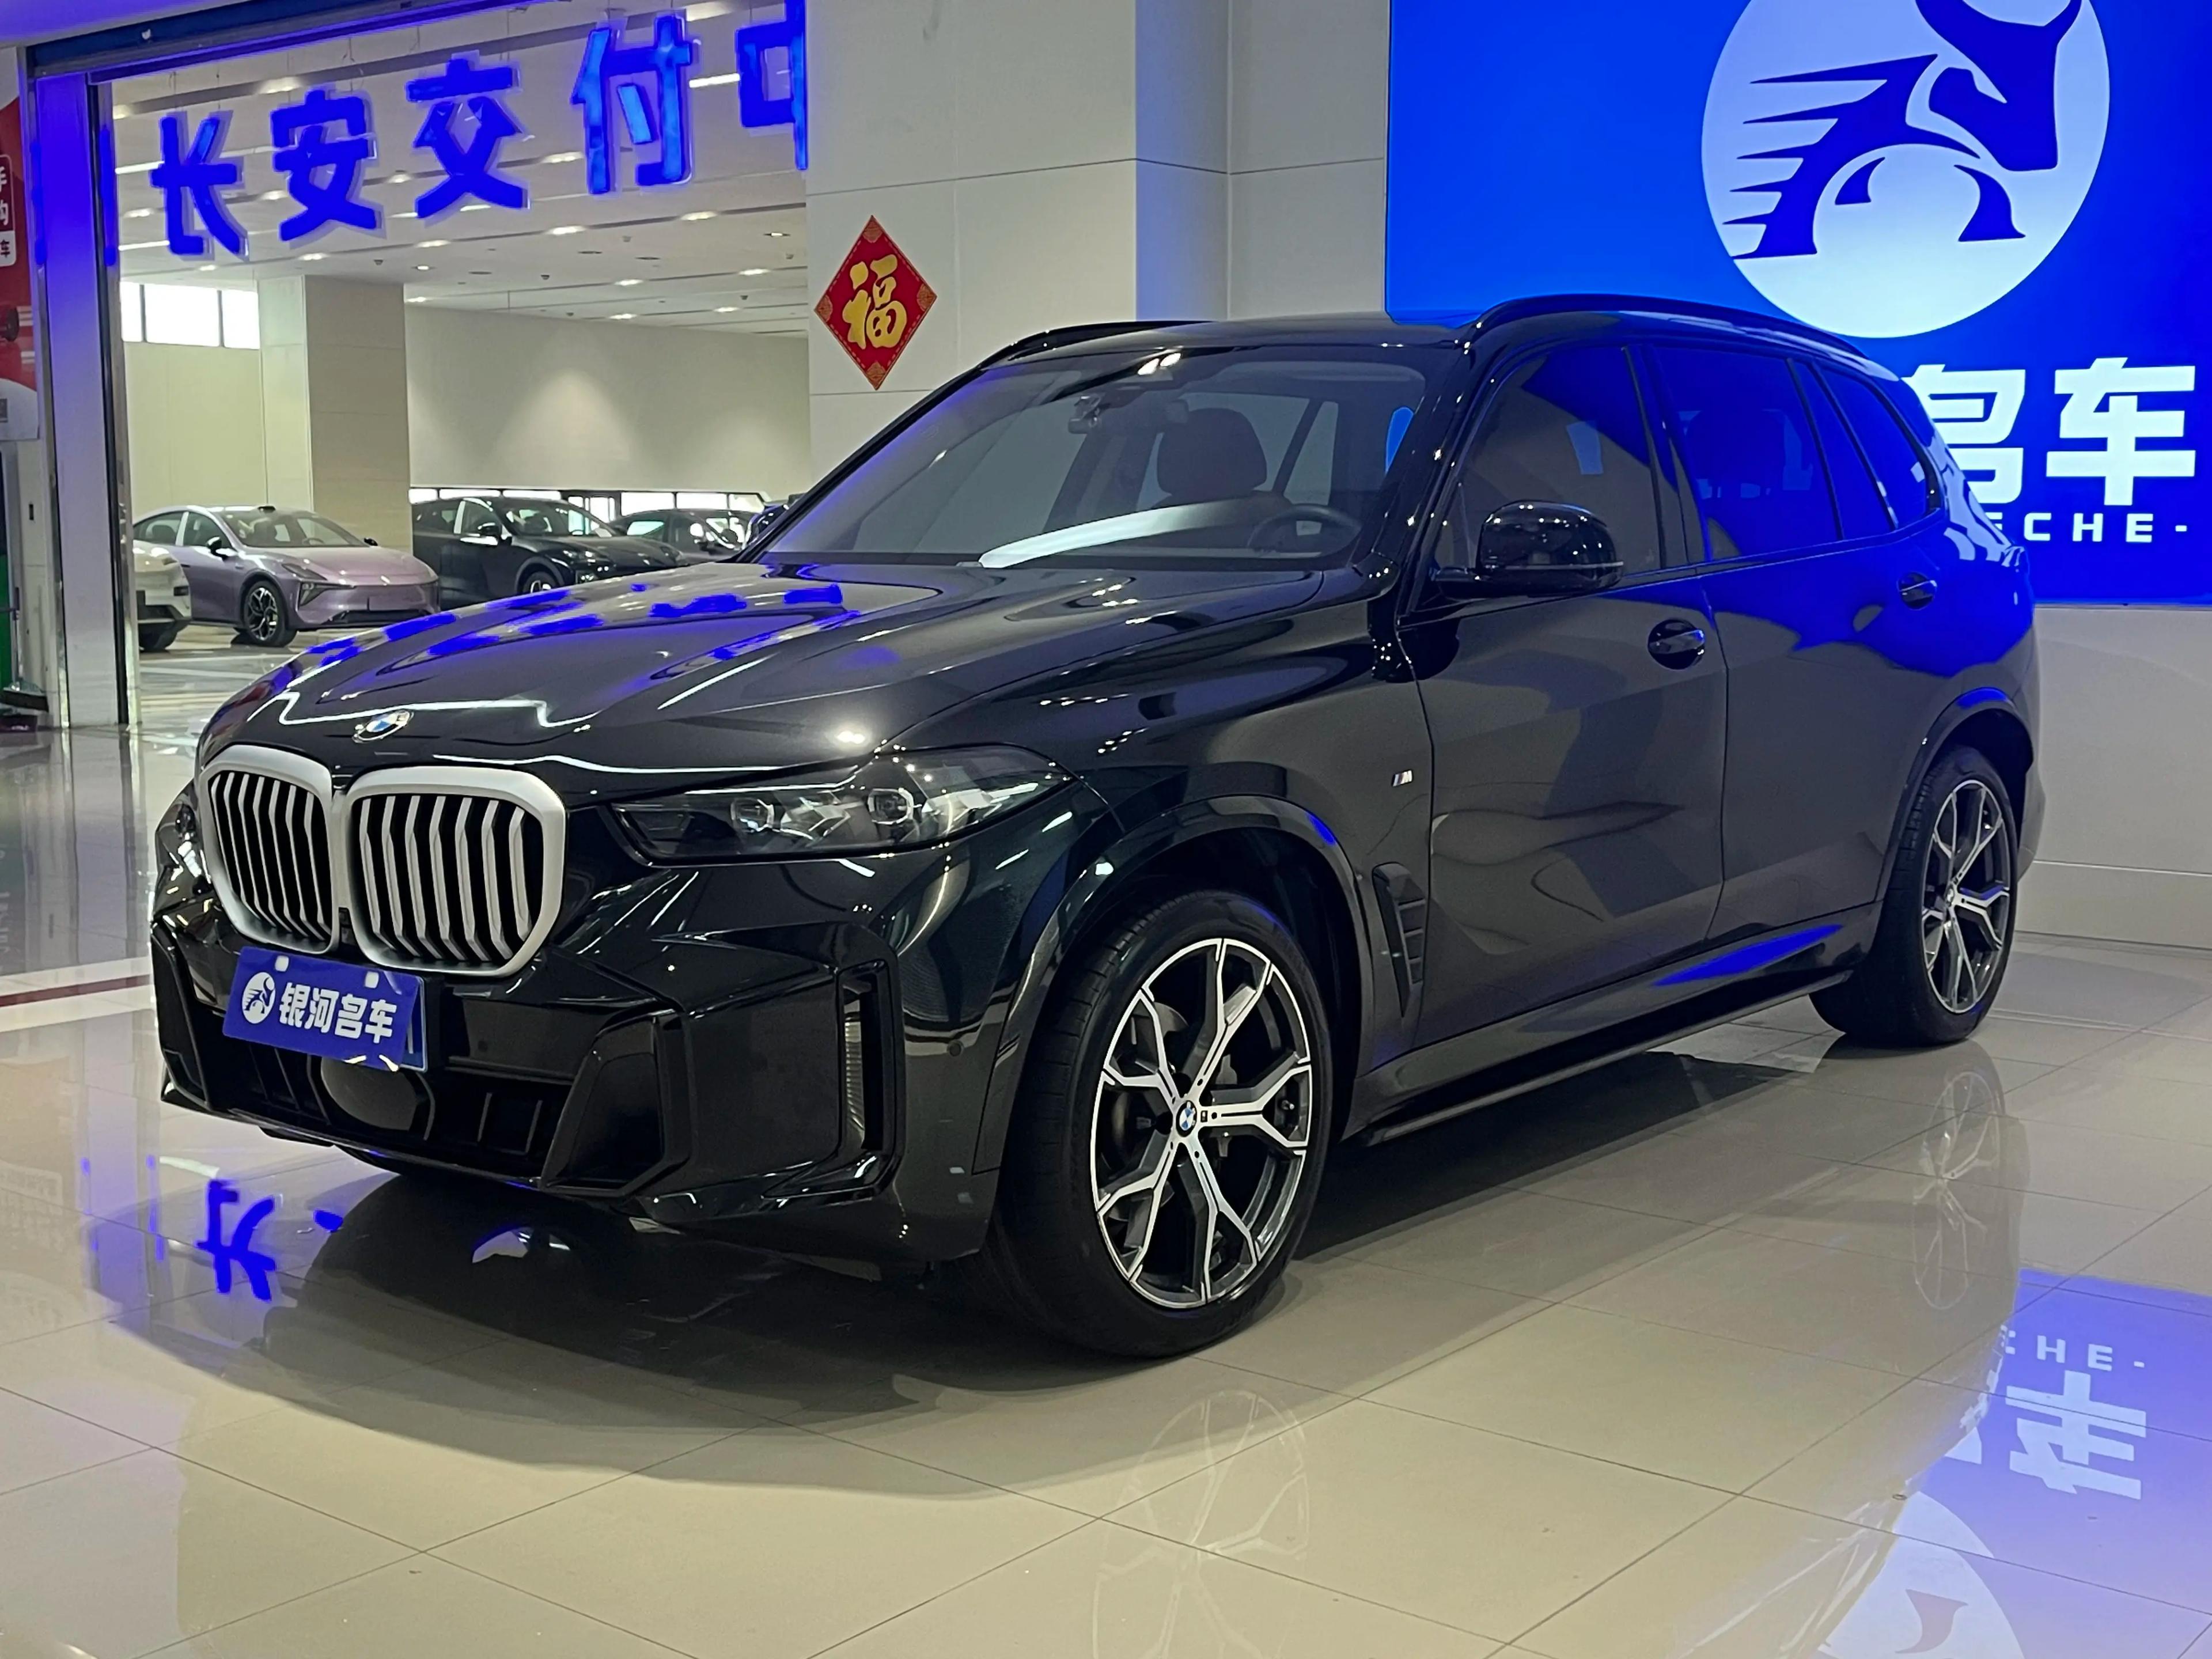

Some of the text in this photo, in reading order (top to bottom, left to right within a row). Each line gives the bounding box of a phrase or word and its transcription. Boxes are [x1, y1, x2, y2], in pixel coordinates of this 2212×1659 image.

[842, 254, 907, 350] 福
[279, 982, 397, 1044] 银河名车
